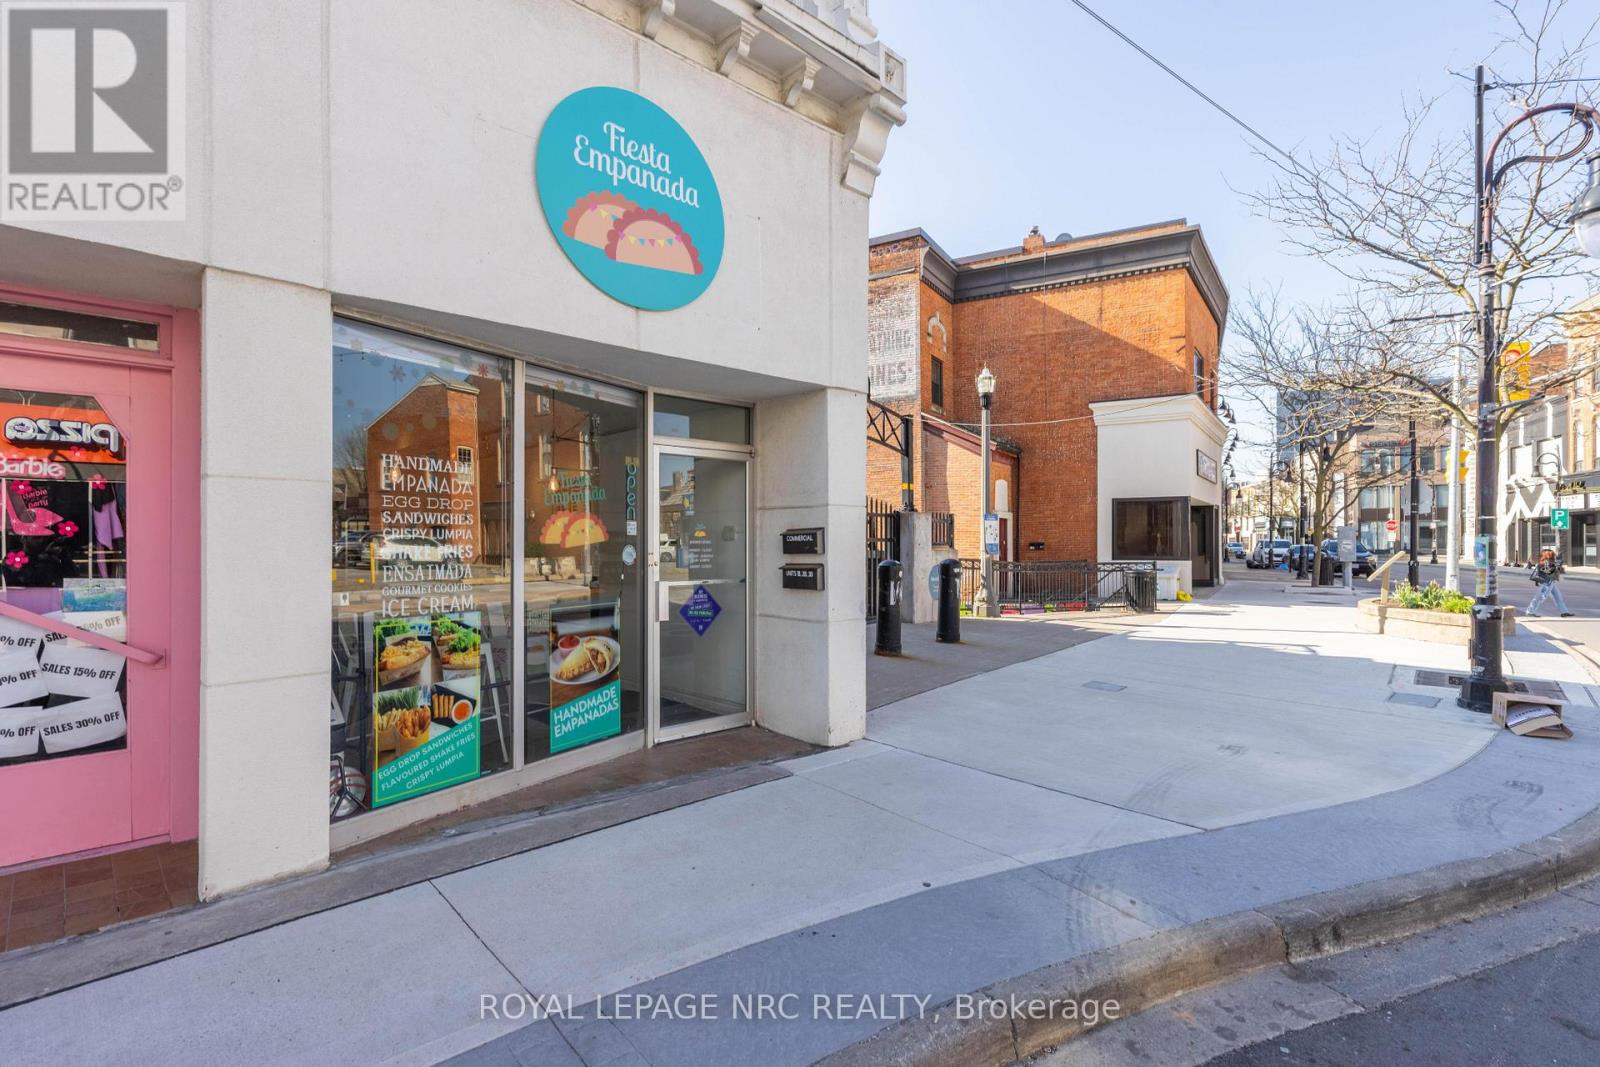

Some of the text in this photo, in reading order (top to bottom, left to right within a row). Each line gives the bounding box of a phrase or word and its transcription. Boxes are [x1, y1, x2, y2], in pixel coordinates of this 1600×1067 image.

[603, 121, 671, 174] Fiesta
[573, 134, 699, 208] Empanada
[381, 453, 472, 474] HANDMADE
[381, 472, 473, 496] EMPANADA
[381, 495, 474, 511] EGG DROP
[382, 511, 474, 526] SANDWICHES
[1554, 510, 1565, 521] P
[383, 528, 473, 540] CRISPY LUMPIA
[382, 583, 473, 597] GOURMET COOKIES
[382, 595, 474, 618] ICE CREAM
[104, 616, 121, 627] OFF
[17, 638, 37, 648] OFF
[45, 632, 68, 643] SAL
[19, 670, 38, 681] OFF
[42, 663, 116, 681] SALES 15% OFF
[553, 686, 617, 724] HANDMADE
[43, 711, 121, 737] SALES 30% OFF
[554, 700, 619, 738] EMPANADAS
[17, 726, 36, 737] OFF
[378, 722, 473, 780] EGG DROP SANDWICHES
[381, 732, 476, 791] FLAVOURED SHAKE FRIES
[406, 751, 465, 789] CRISPY LUMPIA
